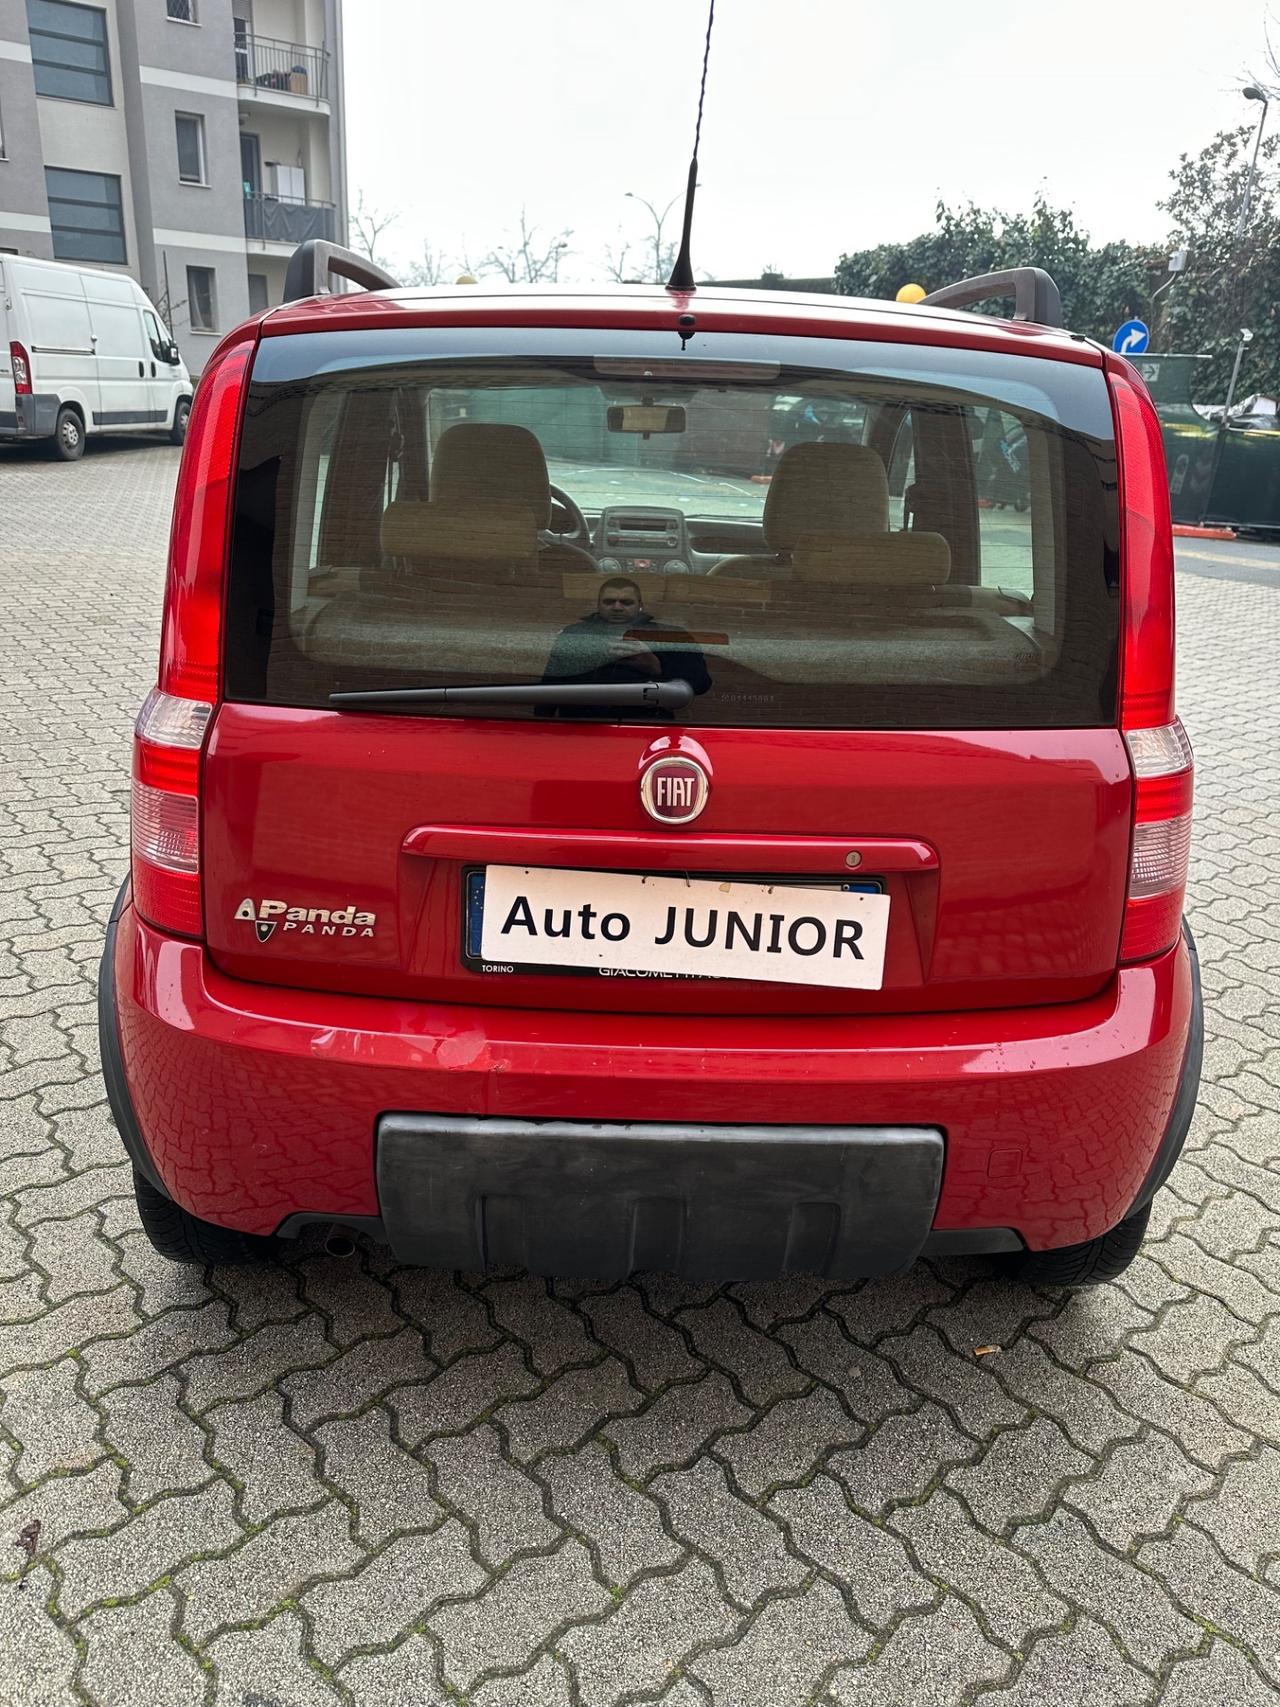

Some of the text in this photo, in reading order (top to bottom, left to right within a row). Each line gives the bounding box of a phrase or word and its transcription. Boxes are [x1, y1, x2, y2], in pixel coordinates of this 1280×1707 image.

[657, 777, 695, 807] FIAT
[283, 921, 374, 937] PANDA
[501, 895, 865, 960] Auto JUNIOR
[482, 964, 514, 973] TORINO
